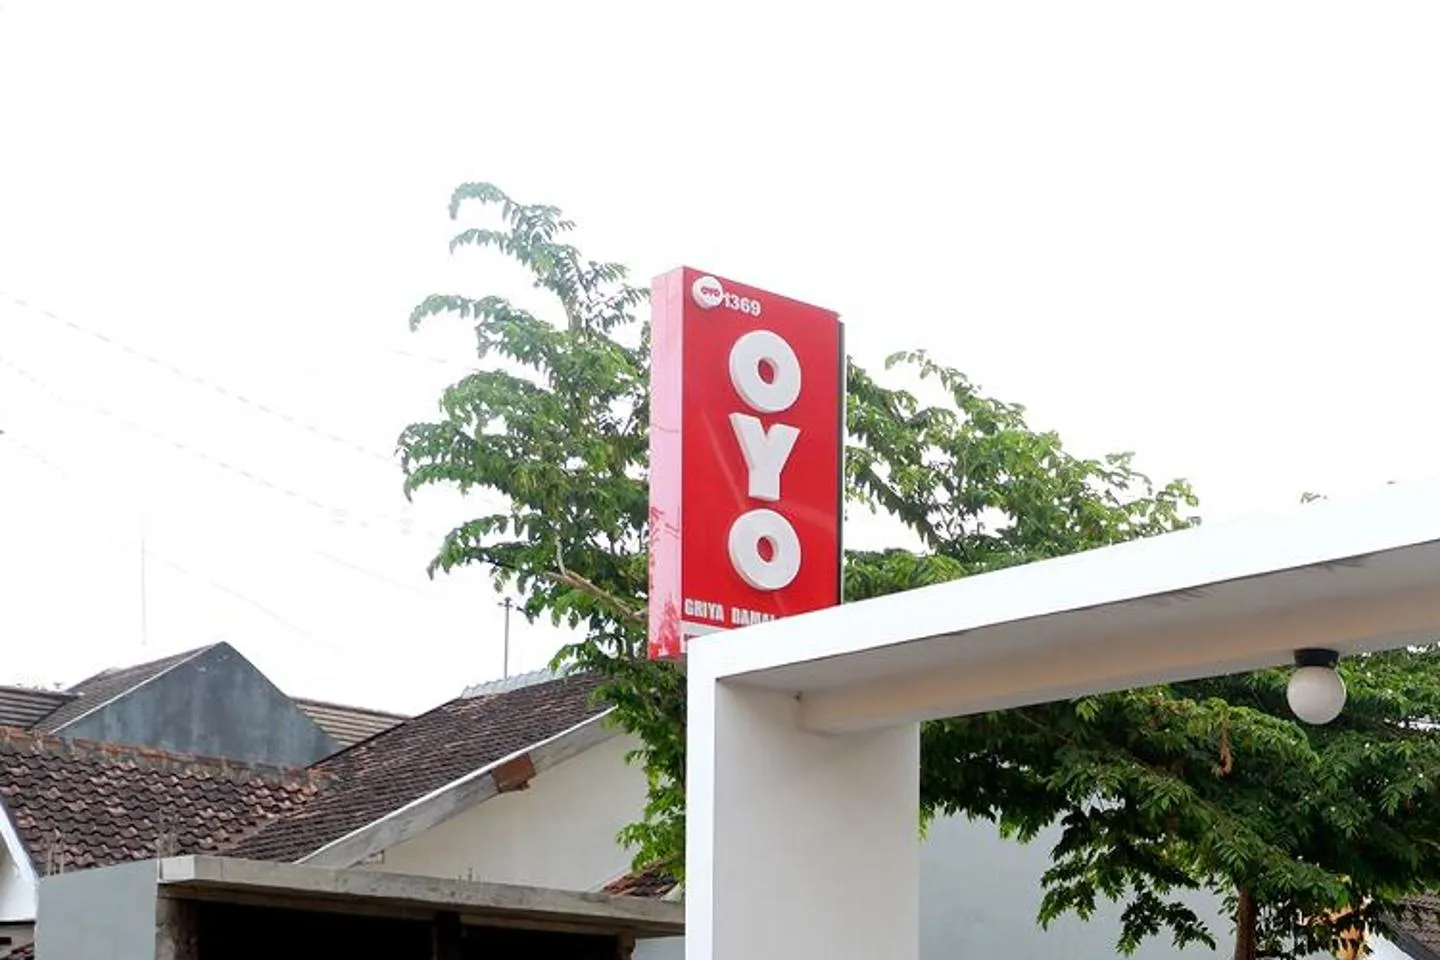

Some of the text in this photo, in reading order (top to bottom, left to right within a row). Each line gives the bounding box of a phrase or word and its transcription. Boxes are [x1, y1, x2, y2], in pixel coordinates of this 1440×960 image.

[723, 291, 762, 317] 1369
[728, 330, 802, 591] OYO
[684, 598, 725, 622] GRIYA
